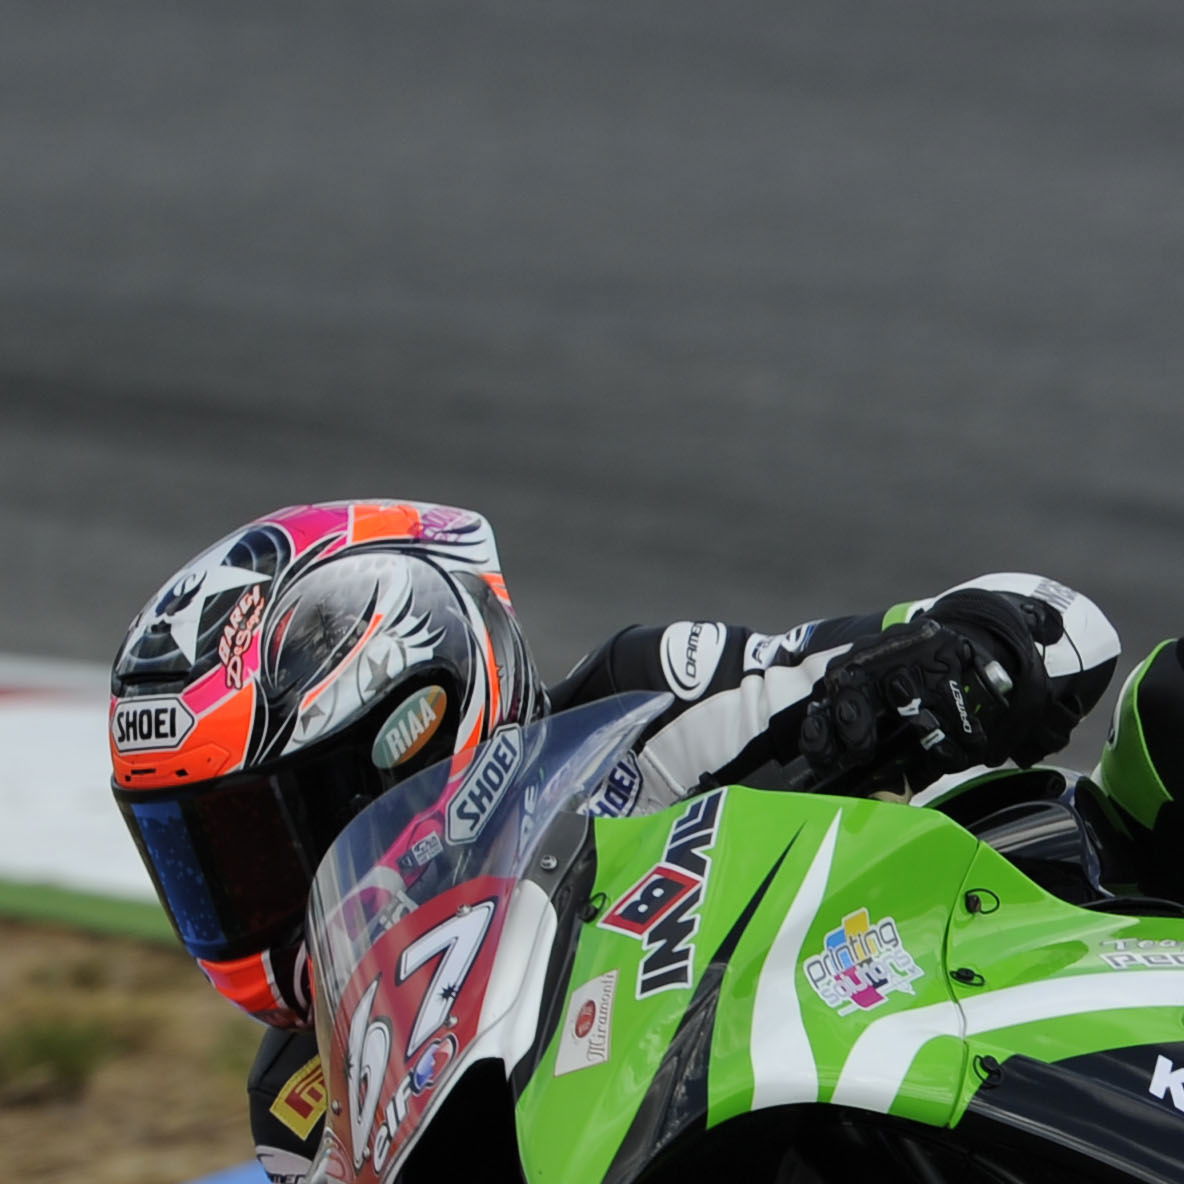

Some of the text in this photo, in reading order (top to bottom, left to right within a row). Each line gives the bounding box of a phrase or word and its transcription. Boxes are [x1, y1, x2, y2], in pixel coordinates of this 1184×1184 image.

[684, 623, 703, 679] DAME
[117, 707, 177, 742] SHOEI
[386, 697, 436, 761] RIAA
[456, 735, 519, 832] SHOEI
[347, 896, 498, 1176] 67
[373, 1070, 416, 1173] elf
